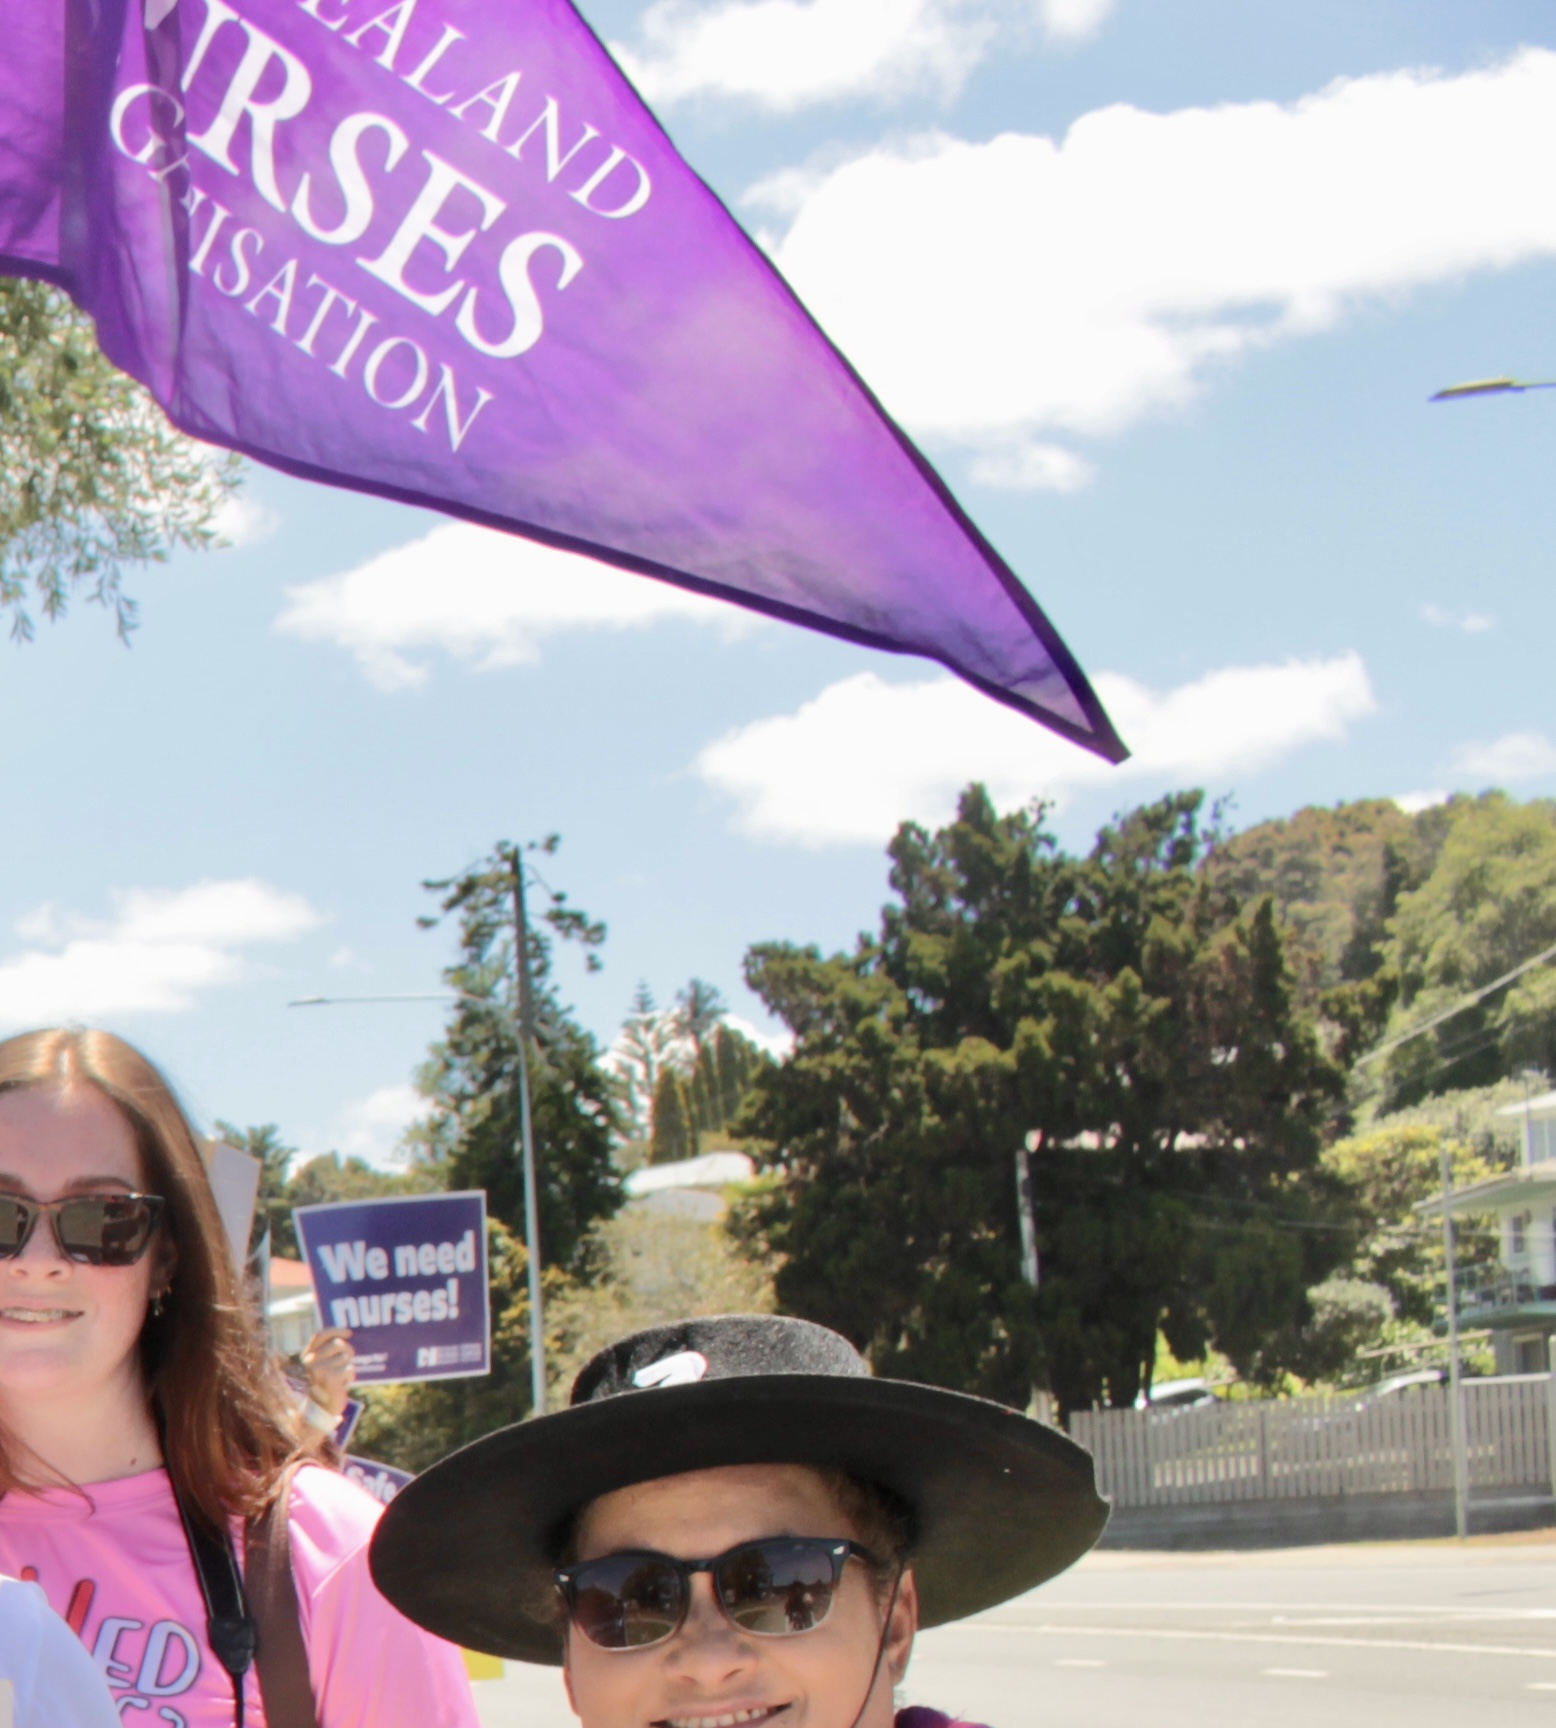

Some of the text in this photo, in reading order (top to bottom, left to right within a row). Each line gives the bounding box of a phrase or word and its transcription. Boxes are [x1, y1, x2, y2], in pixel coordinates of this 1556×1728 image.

[109, 83, 493, 453] GISATION
[317, 1229, 475, 1283] We need
[331, 1278, 459, 1328] nurses!
